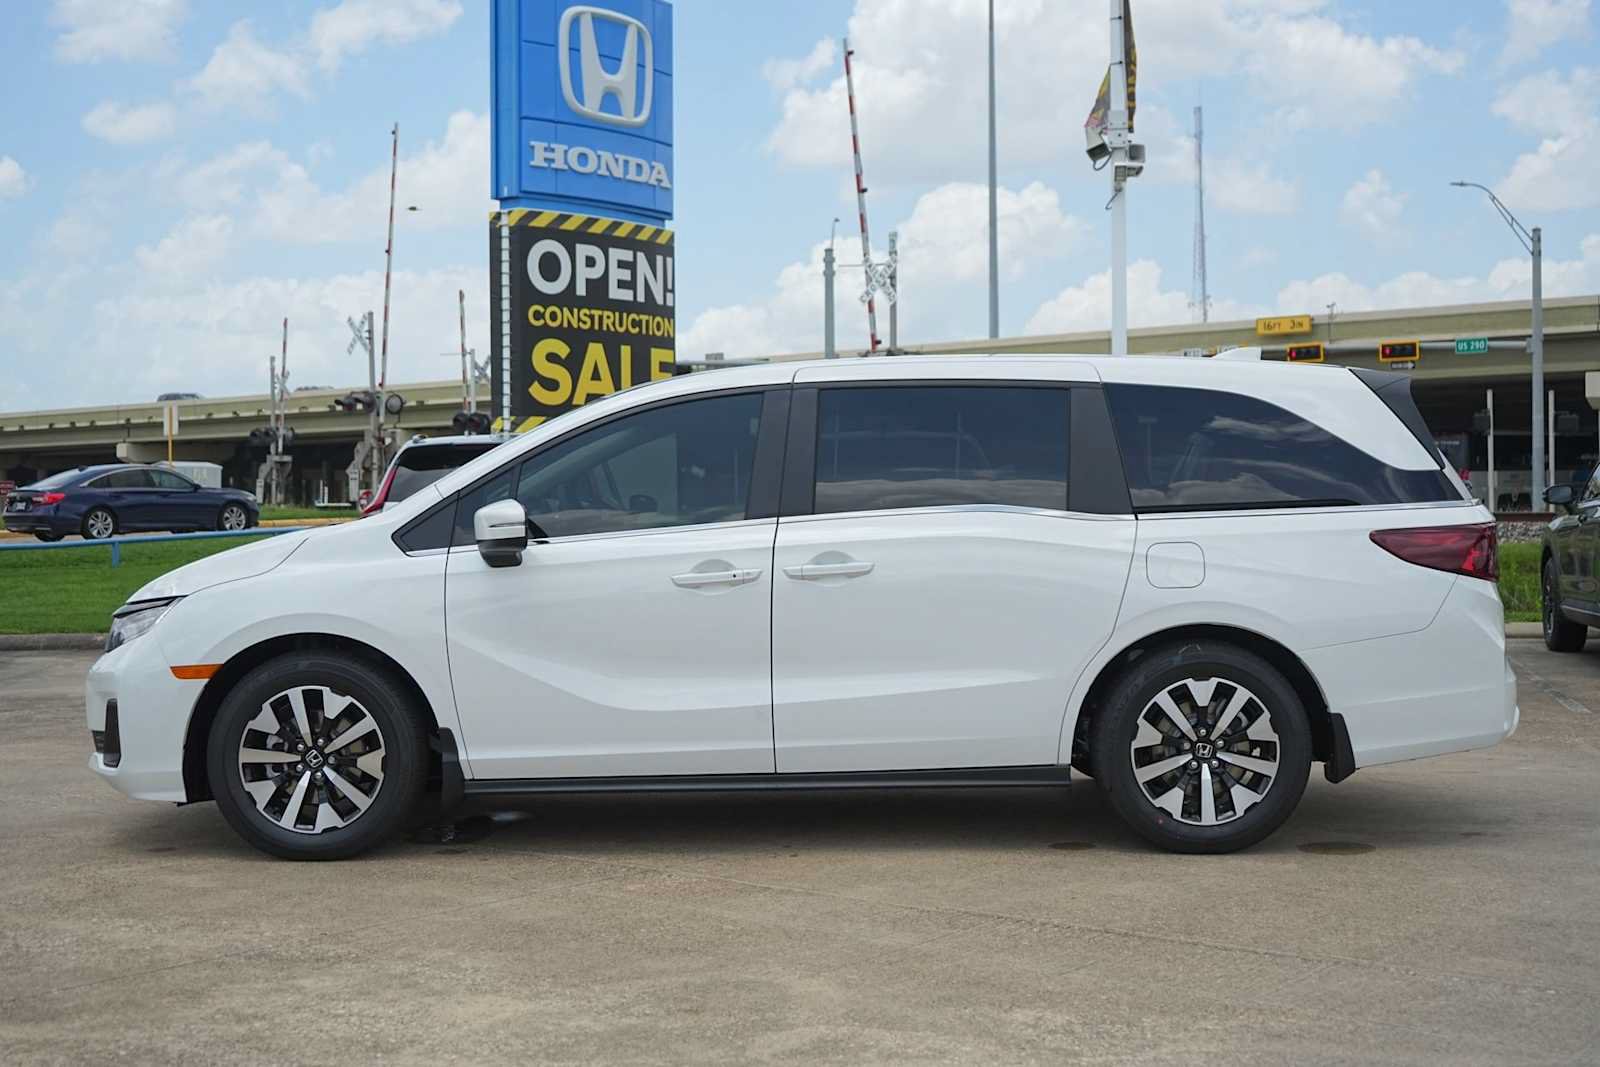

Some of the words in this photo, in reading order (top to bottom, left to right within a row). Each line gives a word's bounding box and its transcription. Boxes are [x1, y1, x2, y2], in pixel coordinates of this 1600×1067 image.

[529, 141, 671, 188] HONDA
[527, 239, 673, 306] OPEN!
[528, 304, 673, 337] CONSTRUCTION
[1457, 341, 1468, 350] US
[1470, 340, 1485, 350] 290
